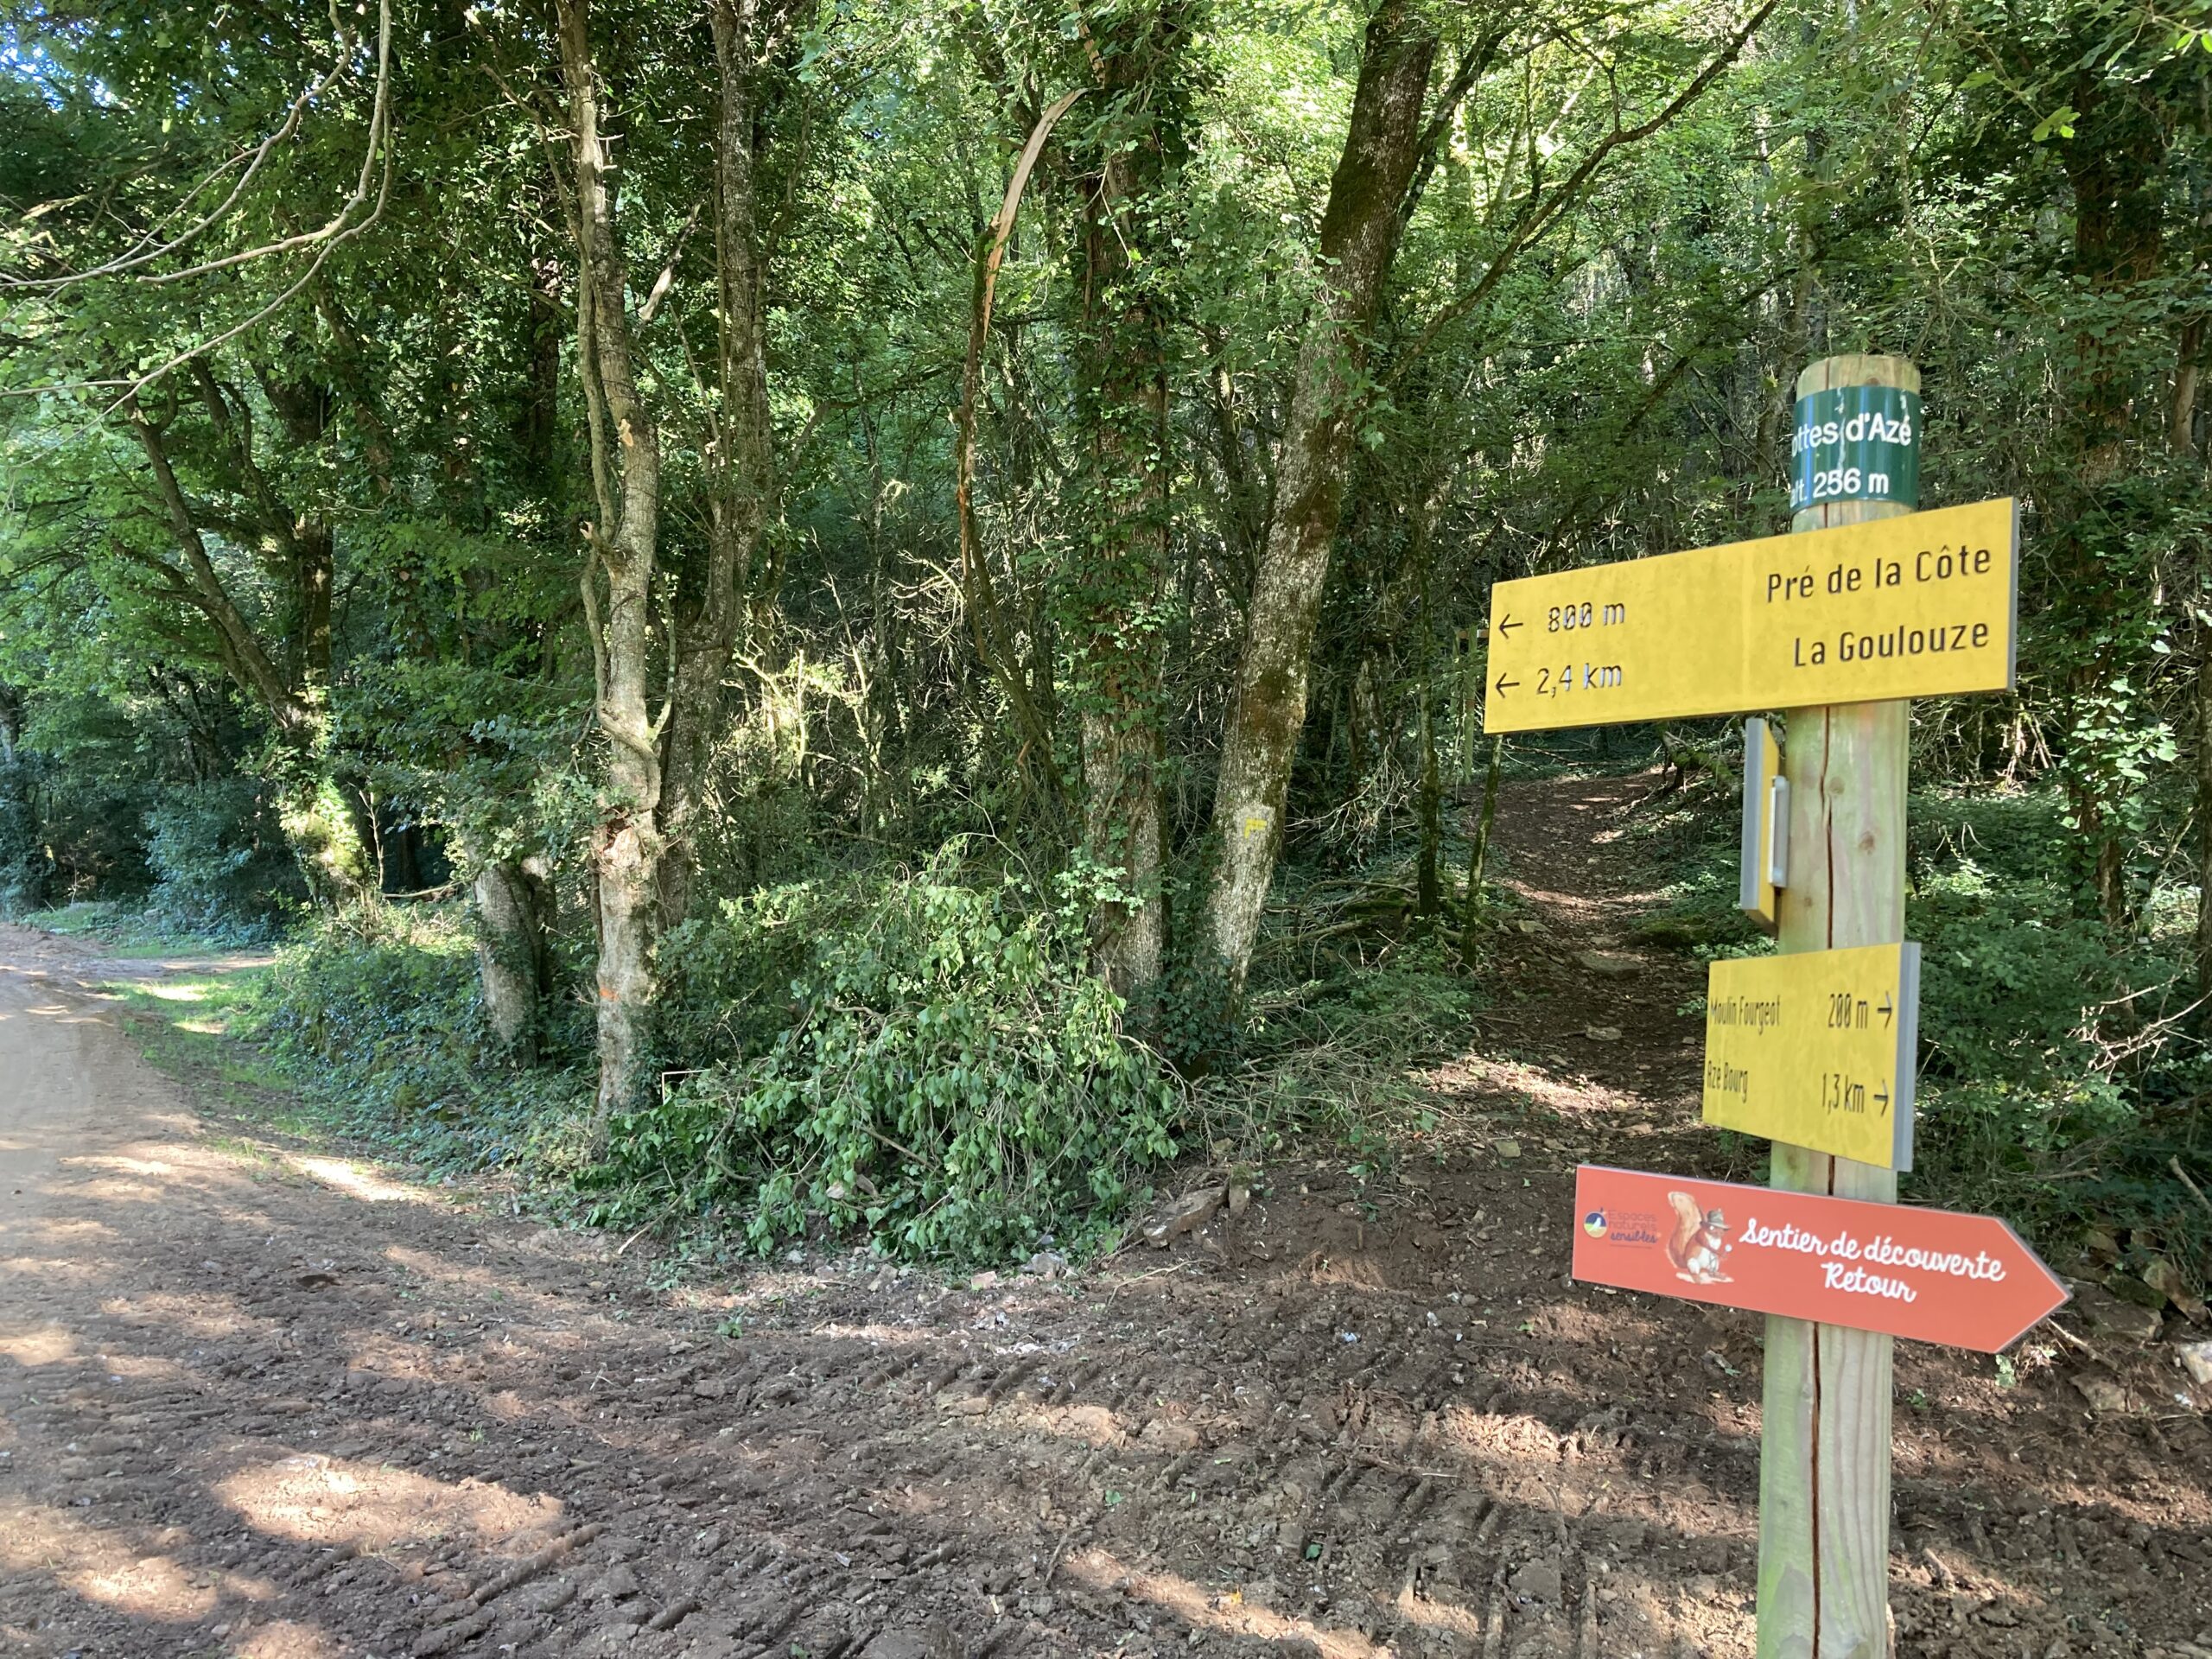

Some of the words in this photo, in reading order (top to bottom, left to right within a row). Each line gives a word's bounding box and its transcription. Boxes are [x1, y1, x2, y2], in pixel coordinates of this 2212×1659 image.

[1845, 412, 1912, 446] d'Azé
[1812, 467, 1862, 499] 256
[1868, 473, 1889, 494] m
[1767, 565, 1814, 603] Pré
[1827, 563, 1861, 594] de
[1875, 557, 1901, 588] la
[1916, 544, 1991, 583] Côte
[1548, 601, 1592, 632] 800
[1603, 602, 1624, 626] m
[1794, 637, 1825, 667] La
[1840, 622, 1989, 662] Goulouze
[1536, 664, 1573, 699] 2,4
[1583, 662, 1622, 690] km
[1710, 995, 1737, 1026] Moulin
[1827, 993, 1852, 1028] 200
[1855, 999, 1868, 1028] m
[1723, 1062, 1749, 1103] Bourg
[1821, 1071, 1841, 1116] 1,3
[1844, 1075, 1865, 1114] km
[1610, 1230, 1659, 1244] sensibles
[1738, 1217, 1829, 1256] Sentier
[1829, 1230, 1862, 1260] de
[1864, 1235, 2007, 1282] découverte
[1820, 1261, 1918, 1303] Retour
